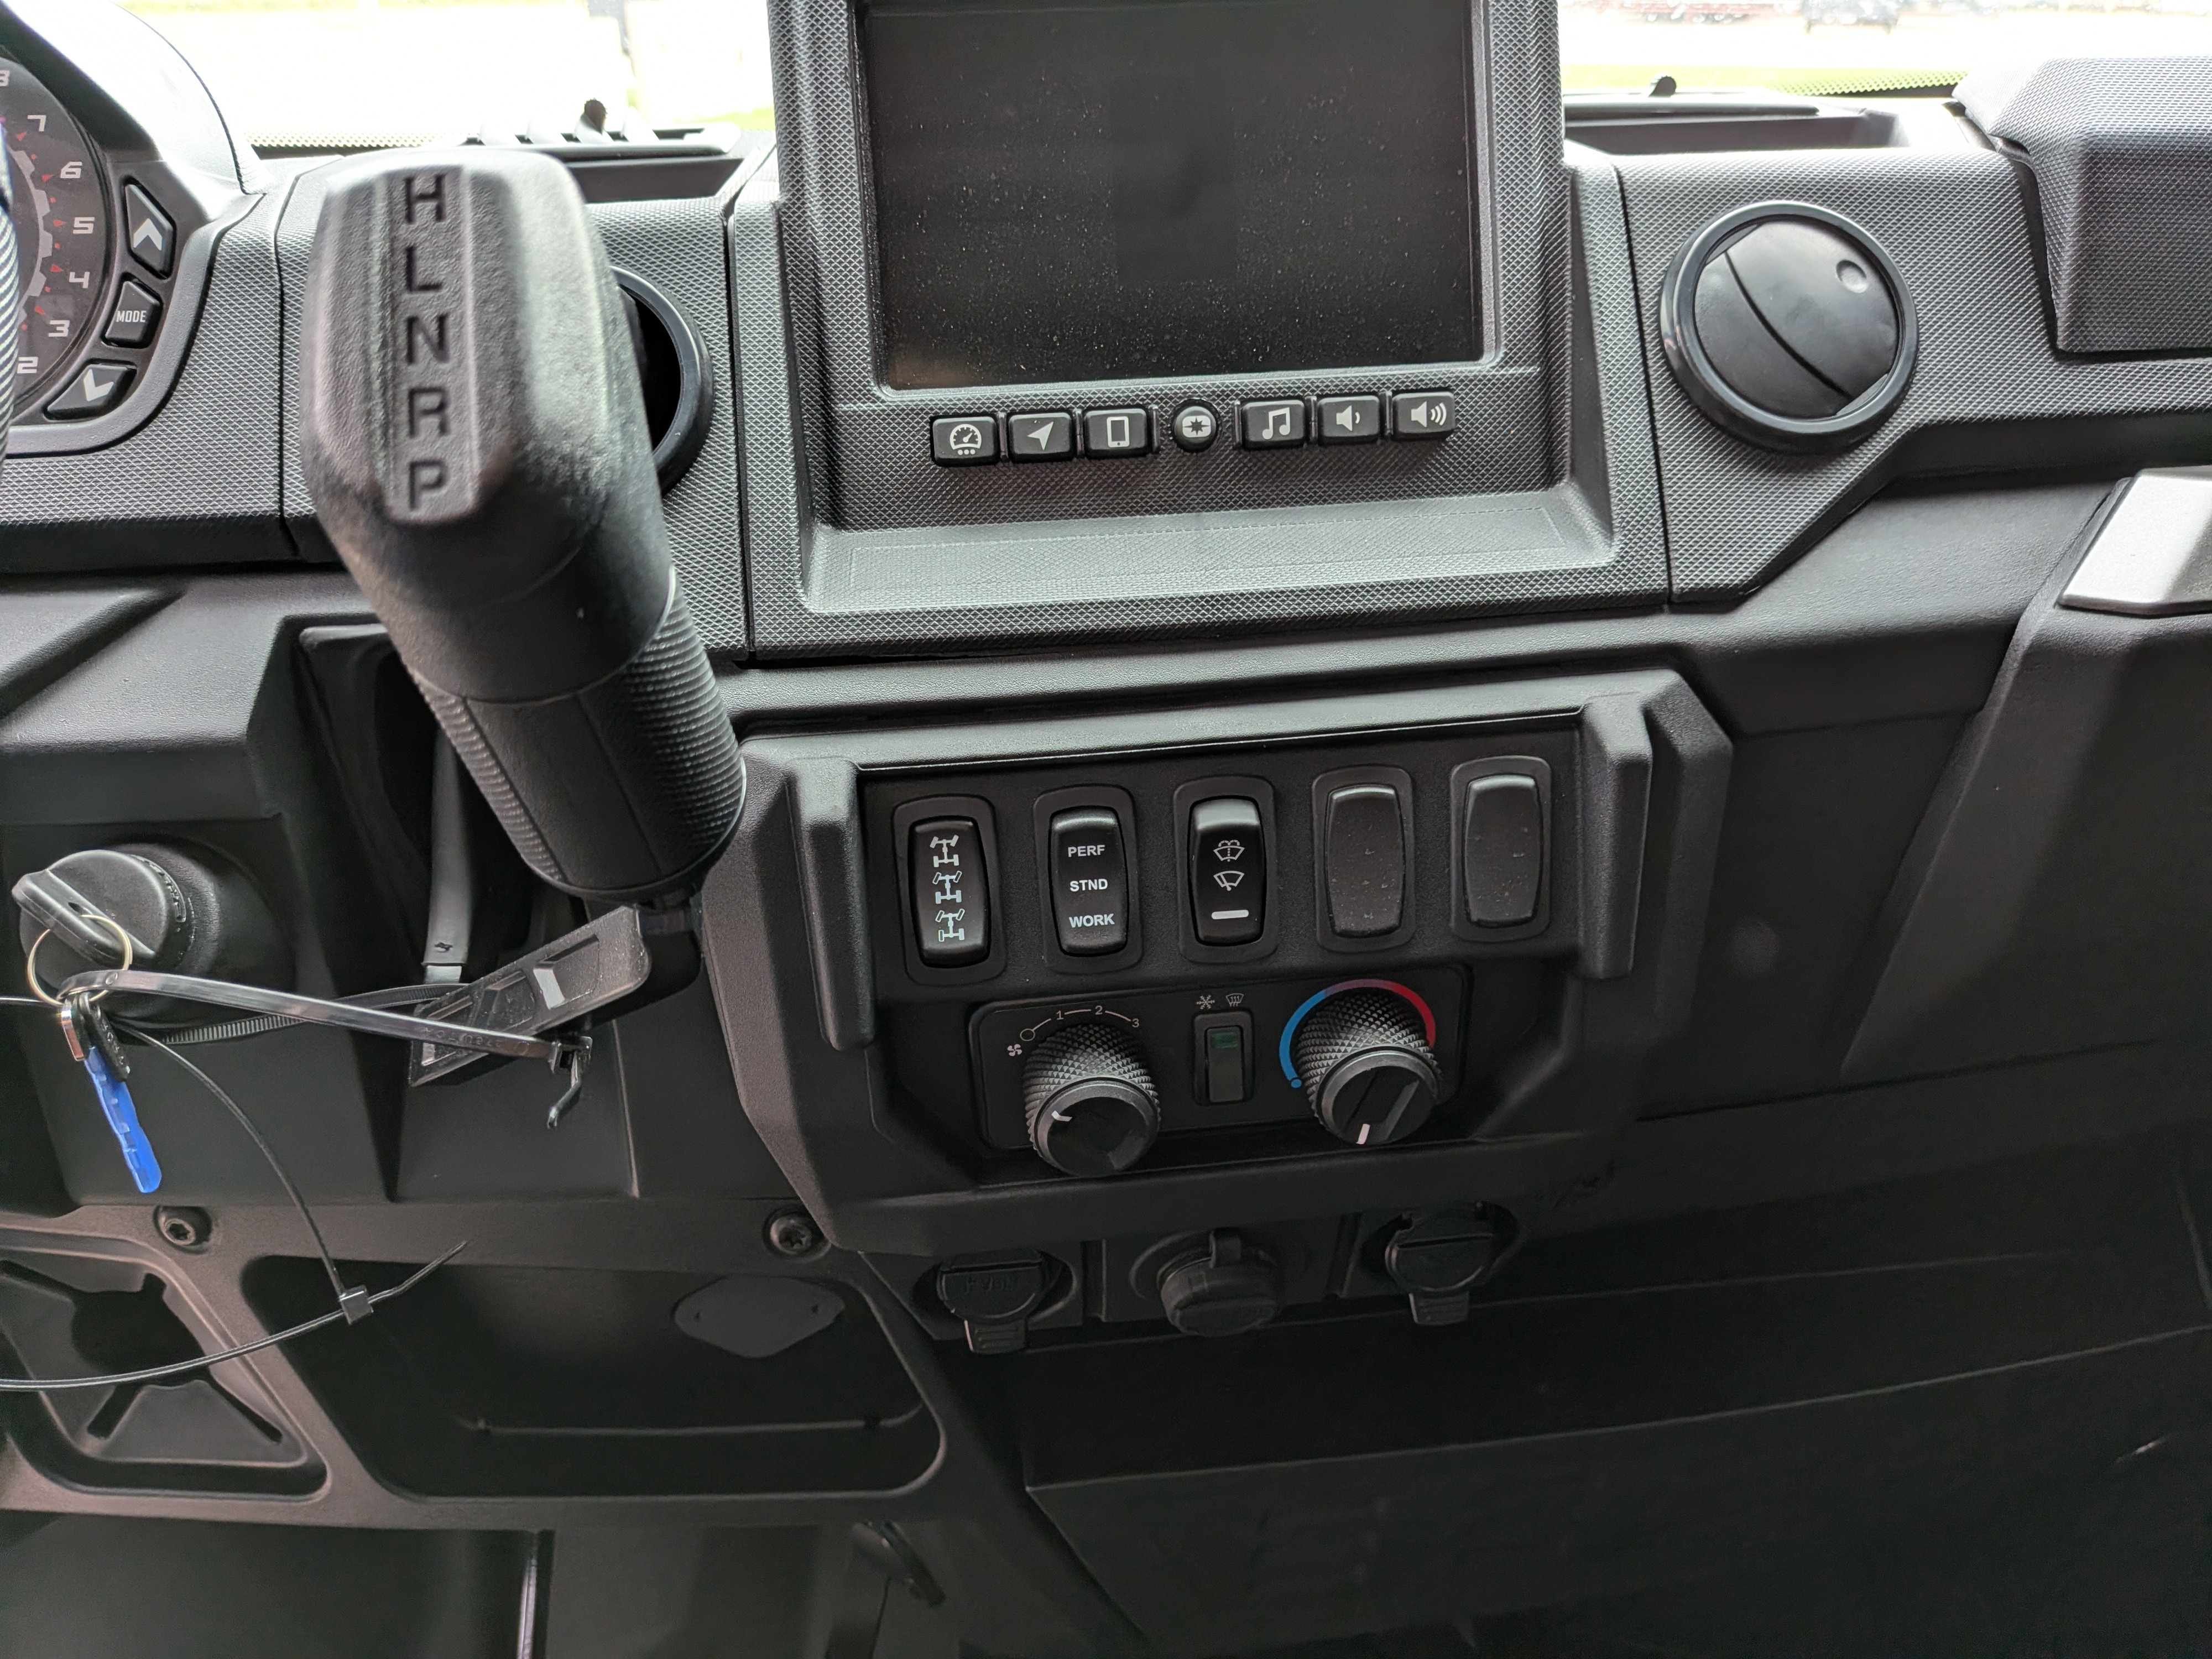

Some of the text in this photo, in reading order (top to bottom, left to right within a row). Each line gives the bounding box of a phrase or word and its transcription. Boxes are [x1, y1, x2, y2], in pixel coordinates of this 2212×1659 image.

[28, 114, 46, 132] 7
[60, 161, 82, 179] 6
[405, 174, 444, 225] H
[73, 217, 95, 234] 5
[406, 246, 443, 293] L
[69, 272, 89, 289] 4
[117, 310, 147, 323] MODE
[48, 320, 70, 337] 3
[406, 312, 451, 365] N
[17, 357, 38, 374] 2
[408, 387, 451, 438] R
[409, 459, 450, 509] P
[1067, 844, 1105, 858] PERF
[1070, 878, 1108, 892] STND
[1069, 913, 1115, 928] WORK
[1056, 1005, 1140, 1027] 1 2 3
